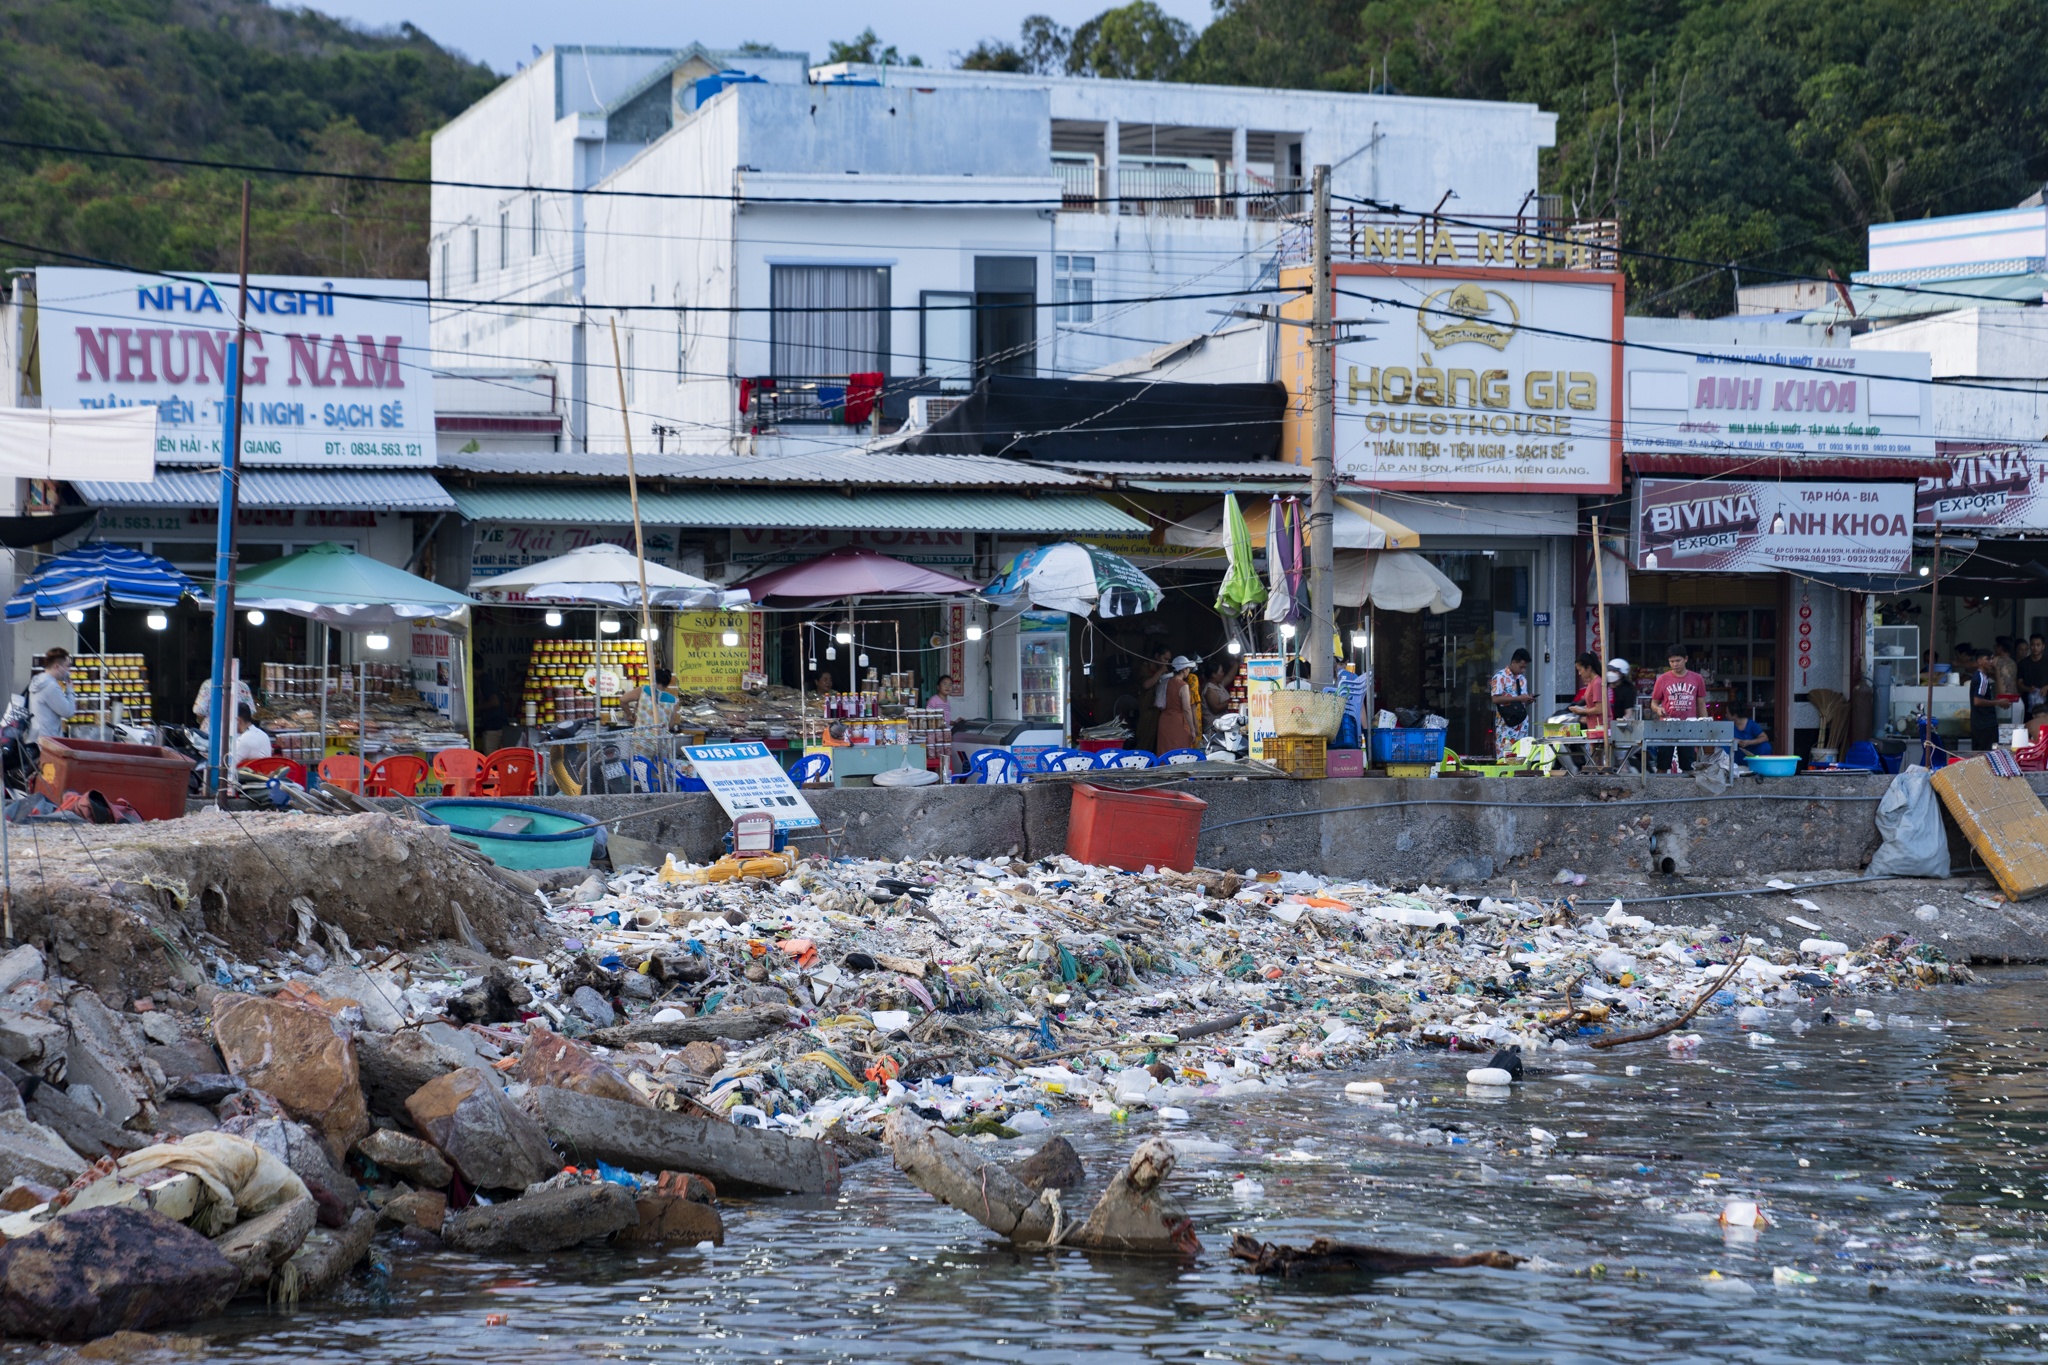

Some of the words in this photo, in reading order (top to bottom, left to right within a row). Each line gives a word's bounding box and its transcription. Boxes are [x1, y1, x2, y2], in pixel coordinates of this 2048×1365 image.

[75, 327, 269, 384] NHUNG
[284, 333, 405, 388] NAM
[1816, 357, 1856, 369] RALLYE
[1695, 376, 1762, 410] ANH
[1772, 379, 1857, 413] KHOA
[324, 403, 373, 431] SẠCH
[1365, 411, 1572, 437] GUESTHOUSE
[156, 434, 176, 453] IÊN
[180, 434, 201, 453] HẢI
[243, 440, 282, 455] GIANG
[325, 441, 346, 456] ĐT:
[1406, 440, 1441, 460] THIỆN
[1449, 441, 1475, 462] TIỆN
[1399, 464, 1417, 472] AN
[1801, 490, 1823, 504] TẠP
[1825, 488, 1850, 502] HÓA
[1860, 492, 1879, 503] BIA
[1939, 492, 2007, 514] EXPORT
[1650, 495, 1758, 533] BIVINA
[1768, 512, 1827, 536] ANH
[1832, 513, 1908, 537] KHOA
[1677, 532, 1738, 550] EXPORT
[1869, 555, 1888, 563] 9292
[1536, 613, 1548, 622] 204
[1666, 682, 1696, 695] HAWAII
[695, 747, 737, 759] ĐIỆN
